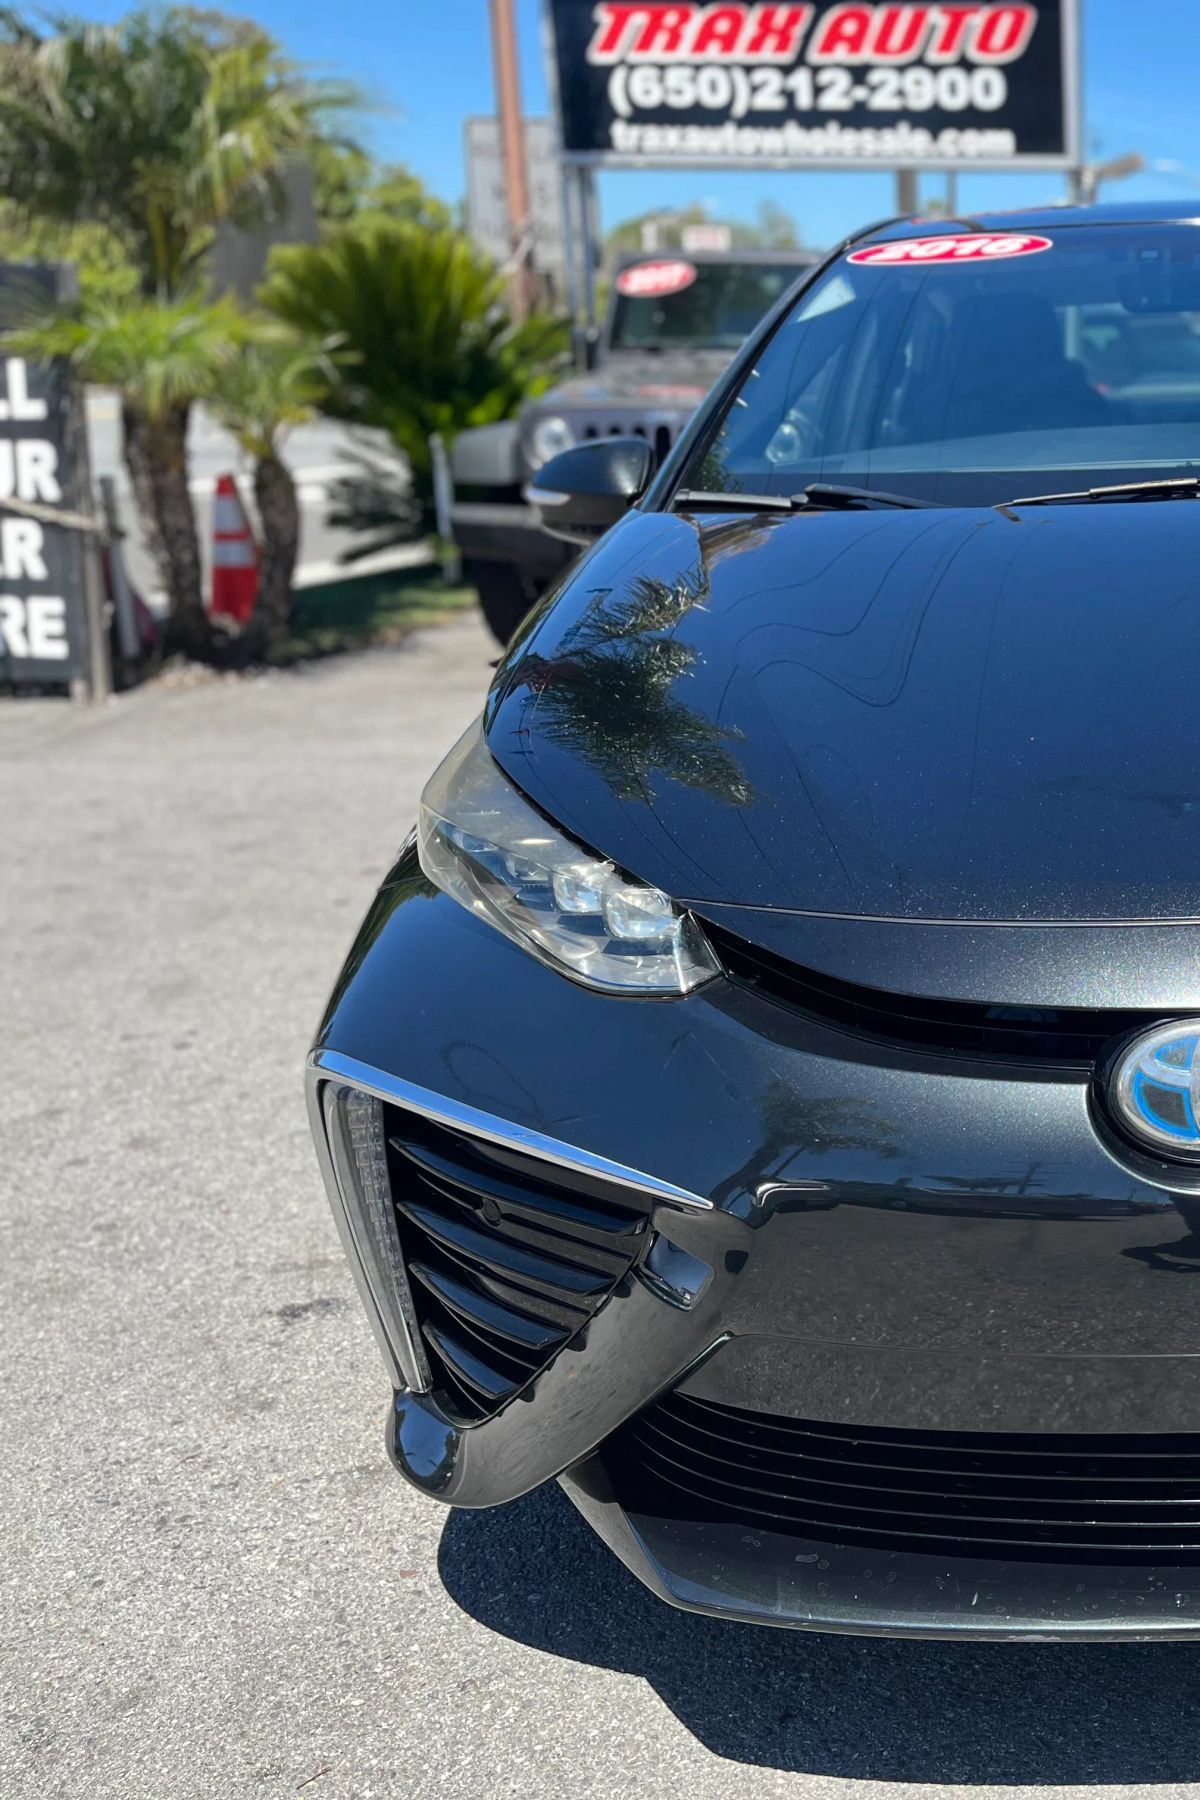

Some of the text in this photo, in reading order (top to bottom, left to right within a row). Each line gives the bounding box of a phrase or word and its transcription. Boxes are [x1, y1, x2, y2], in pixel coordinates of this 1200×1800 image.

[589, 2, 1037, 65] TRAX AUTO
[608, 65, 1007, 119] (650)212-2900
[610, 119, 1016, 155] traxautowholesale.com
[865, 236, 1032, 262] 2016
[0, 357, 48, 421] L
